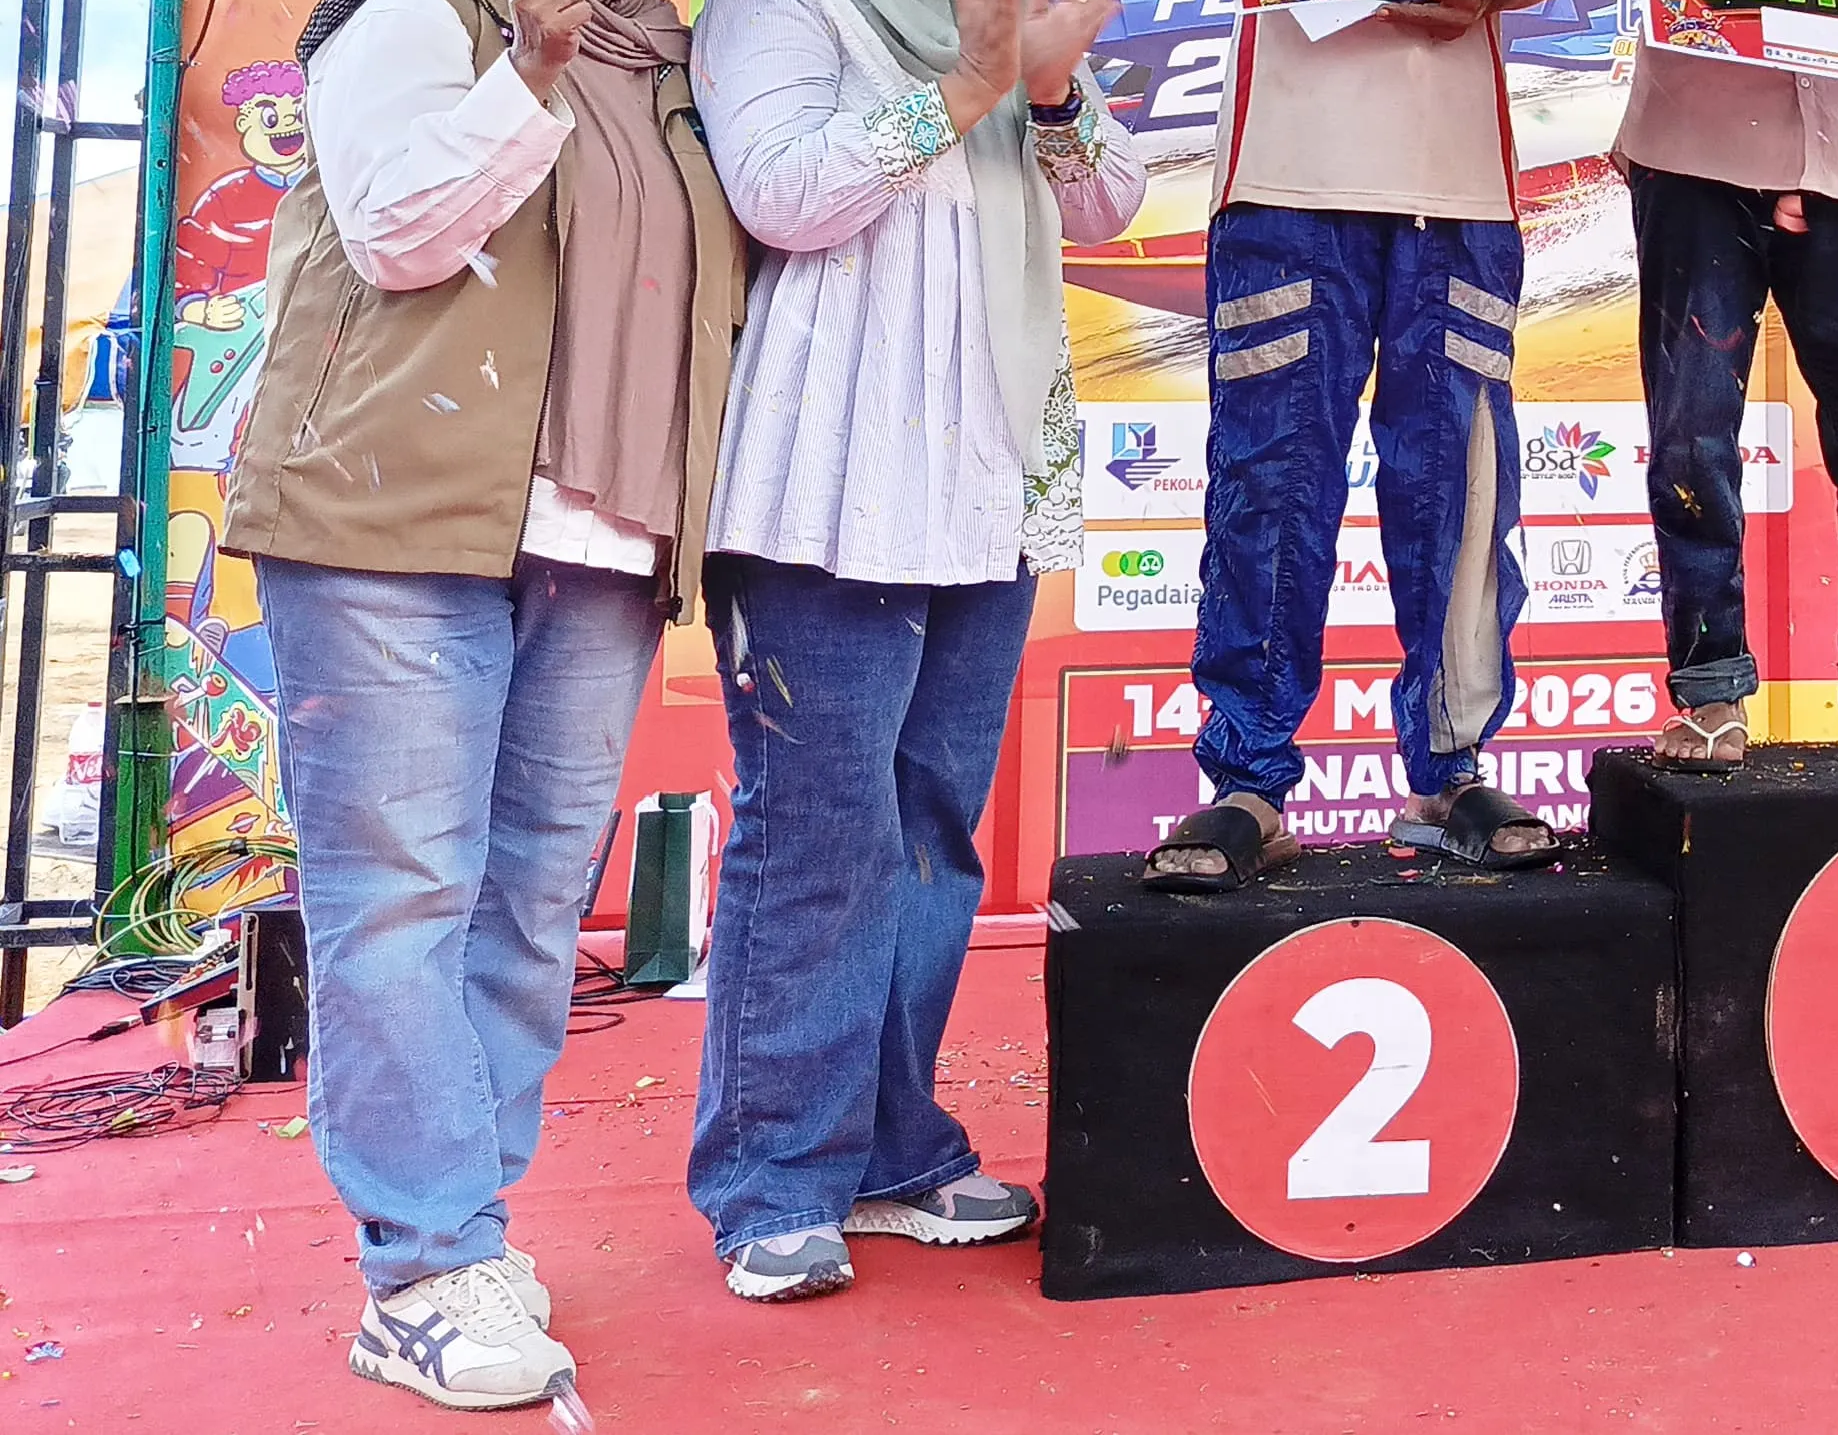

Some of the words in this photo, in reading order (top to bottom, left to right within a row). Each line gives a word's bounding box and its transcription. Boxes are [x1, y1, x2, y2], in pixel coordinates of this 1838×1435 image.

[1521, 437, 1583, 472] gsa
[1098, 583, 1201, 610] Pegadaia
[1534, 579, 1608, 591] HONDA
[1548, 593, 1593, 604] ARISTA
[1286, 977, 1432, 1201] 2
